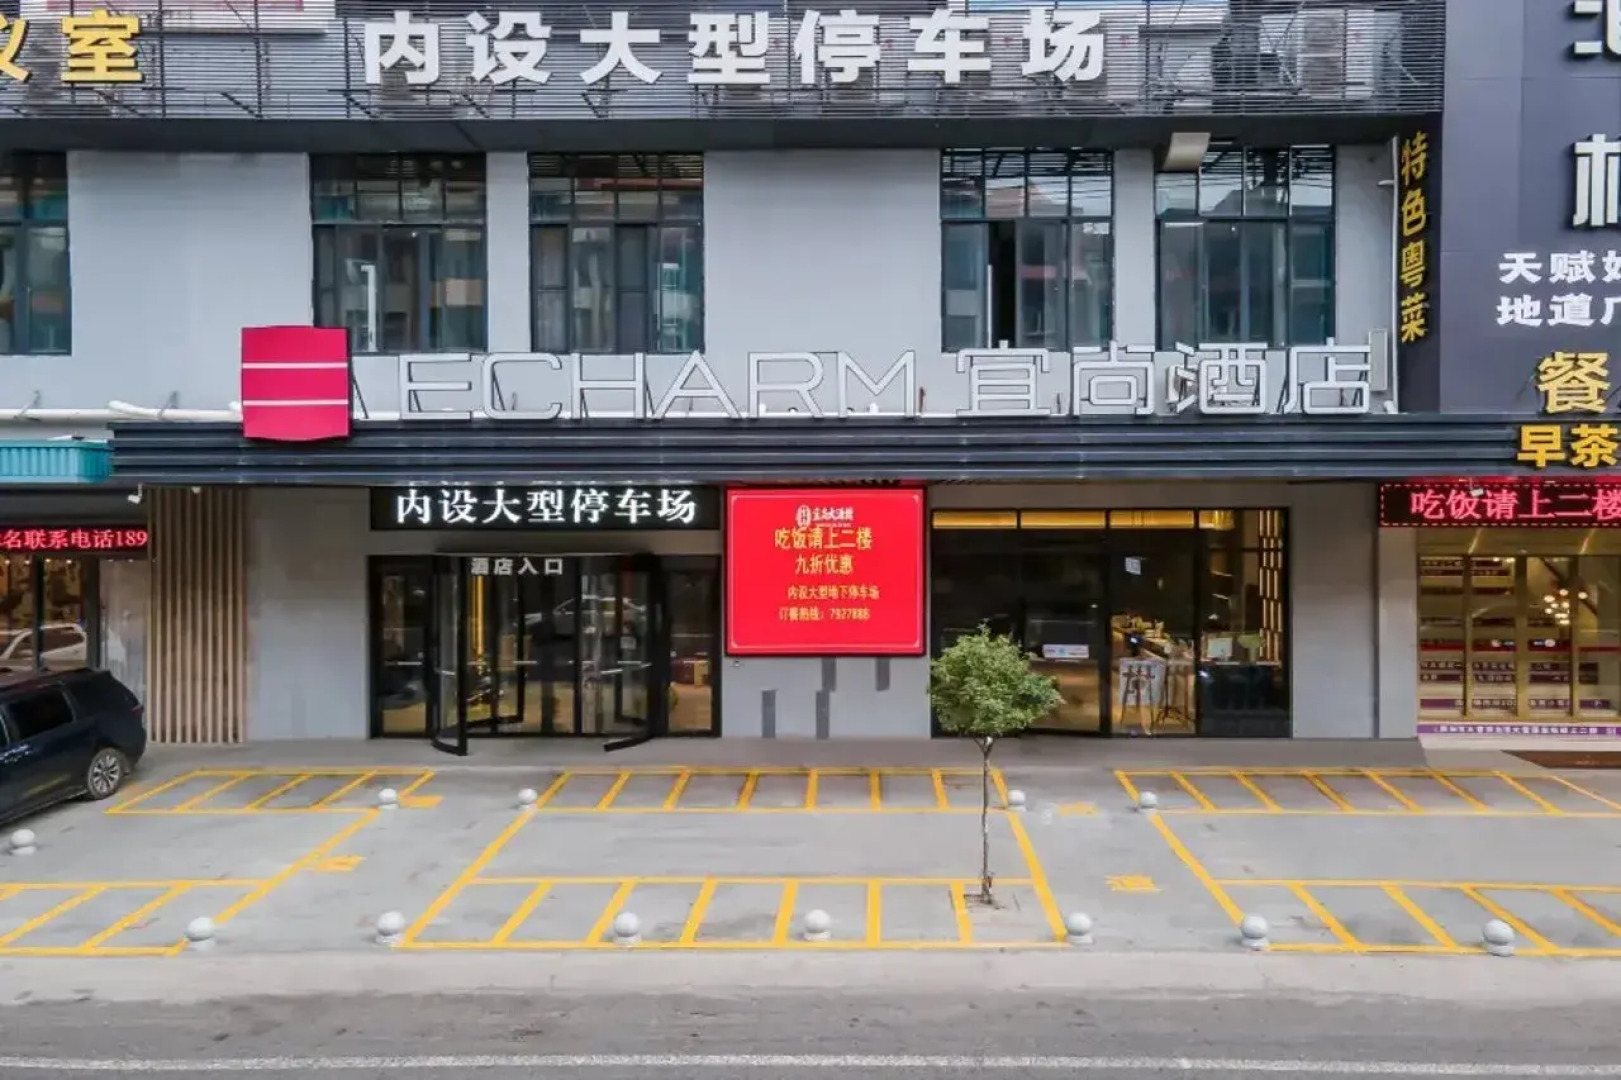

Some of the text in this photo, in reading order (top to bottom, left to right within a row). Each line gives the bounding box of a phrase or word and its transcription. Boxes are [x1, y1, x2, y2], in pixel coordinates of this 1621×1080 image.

[364, 9, 1105, 85] 内设大型停车场
[1401, 130, 1429, 343] 特色粤菜
[399, 336, 1370, 421] ECHARM 宜尚酒店
[1538, 351, 1612, 414] 餐
[1517, 424, 1619, 468] 早茶
[396, 488, 697, 524] 内设大型停车场
[1410, 488, 1621, 520] 吃饭请上二楼
[0, 528, 148, 549] 名联系电话189
[774, 526, 873, 550] 吃饭请上二楼
[470, 557, 564, 576] 酒店入口
[795, 554, 853, 576] 九折优惠
